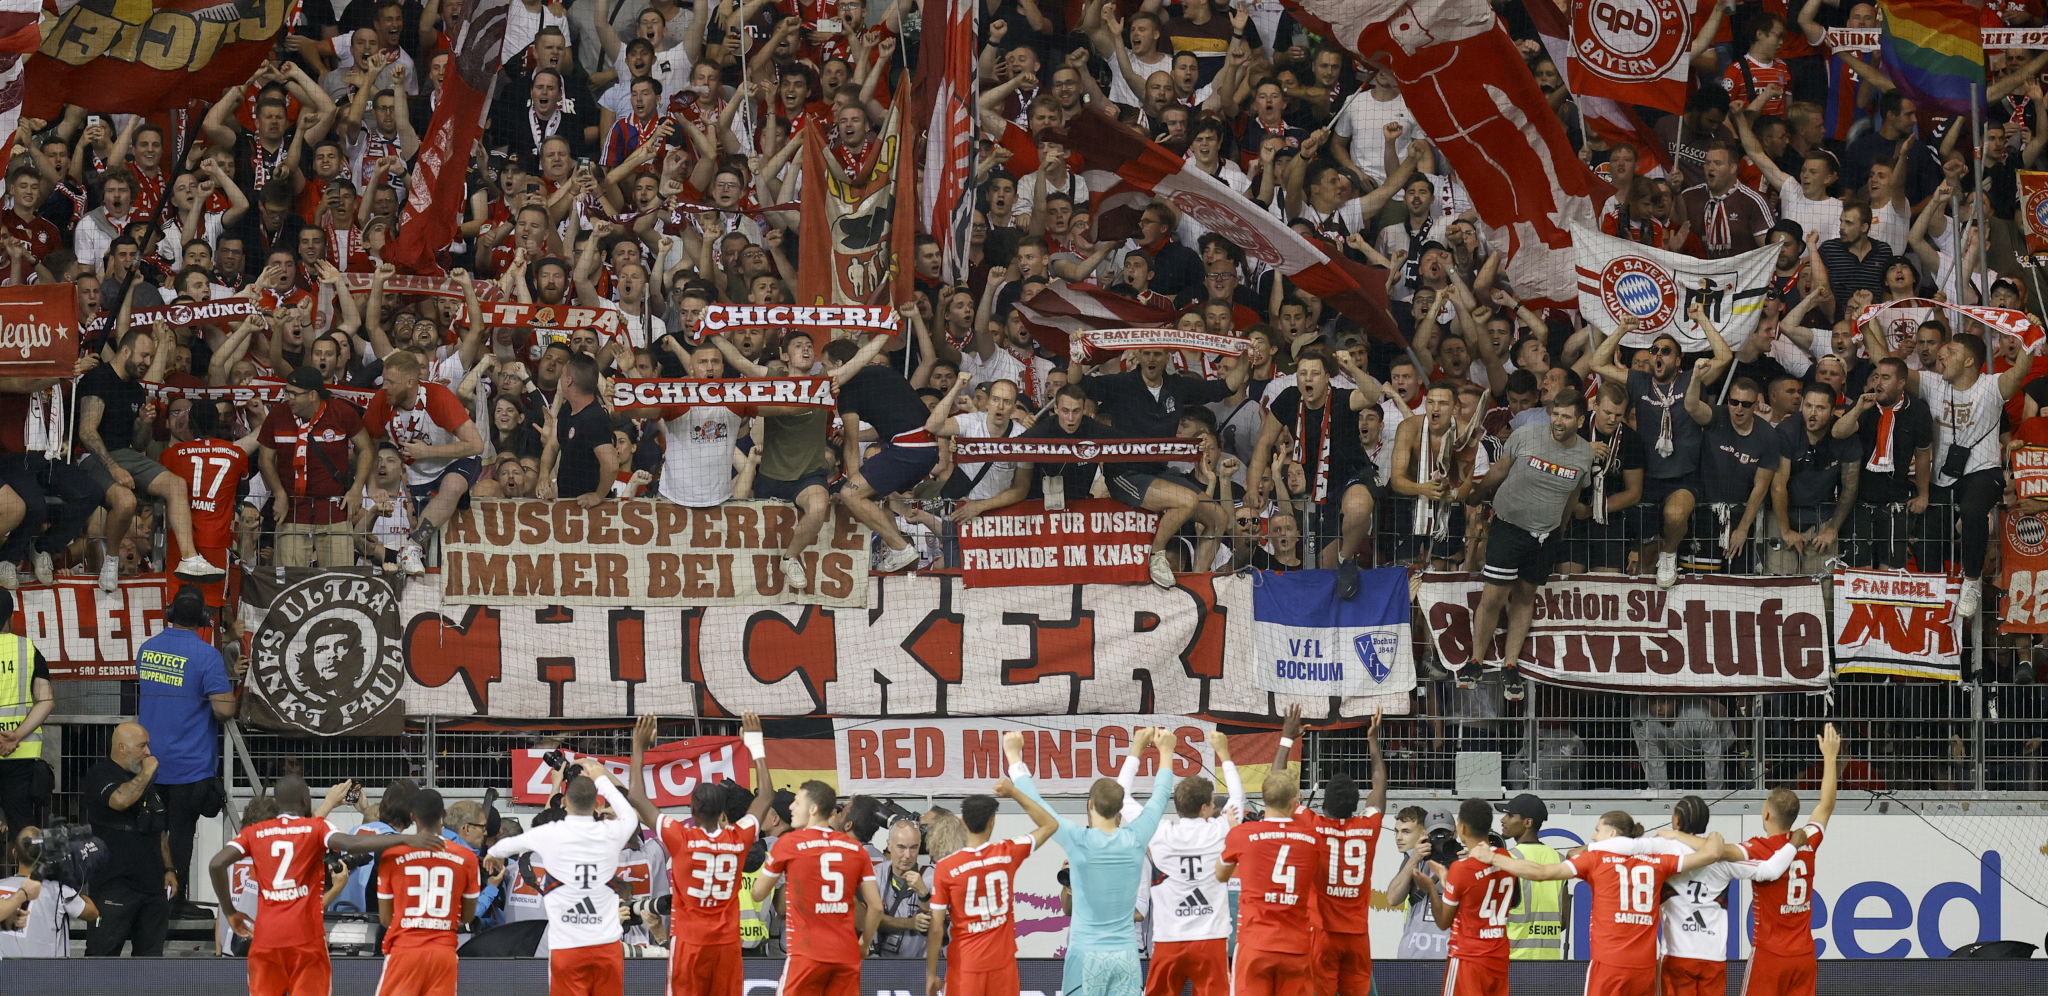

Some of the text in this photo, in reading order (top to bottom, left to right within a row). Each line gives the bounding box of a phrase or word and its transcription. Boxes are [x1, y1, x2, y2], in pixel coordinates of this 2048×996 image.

[1580, 38, 1657, 73] BAYERN
[1624, 260, 1674, 296] BAYERN
[1605, 291, 1655, 331] MÜNEN
[1103, 329, 1161, 341] BAYERN
[1163, 330, 1232, 345] MÜNCHEN
[613, 379, 836, 408] SCHICKERIA
[178, 448, 186, 456] FC
[956, 440, 1199, 457] SCHICKERIA MÜNCHEN
[190, 455, 231, 499] 17
[191, 499, 216, 513] MANÉ
[960, 508, 1159, 538] FREIHEIT FÜR UNSERE
[962, 546, 1058, 570] FREUNDE
[1062, 544, 1087, 568] IM
[445, 550, 630, 598] IMMER
[646, 551, 736, 599] BEI
[1852, 577, 1889, 595] STAY
[1533, 587, 1667, 623] ektion SV
[141, 651, 187, 669] PROTECT
[1289, 638, 1323, 659] VfL
[339, 635, 404, 726] PAULI
[1276, 659, 1344, 682] BOCHUM
[847, 726, 945, 780] RED
[270, 840, 296, 890] 2
[395, 856, 405, 865] FC
[405, 850, 431, 862] BAYERN
[1271, 844, 1296, 893] 4
[1326, 836, 1368, 886] 19
[404, 865, 455, 918] 38
[687, 852, 738, 901] 39
[819, 852, 844, 902] 5
[1326, 885, 1359, 898] DAVIES
[1615, 863, 1655, 913] 18
[1787, 859, 1809, 906] 6
[815, 902, 848, 914] PAVARD
[964, 869, 1009, 921] 40
[1264, 892, 1277, 903] DE
[1479, 876, 1514, 926] 42
[561, 913, 603, 925] adidas
[1175, 905, 1214, 918] adidas
[1408, 931, 1450, 953] FOT
